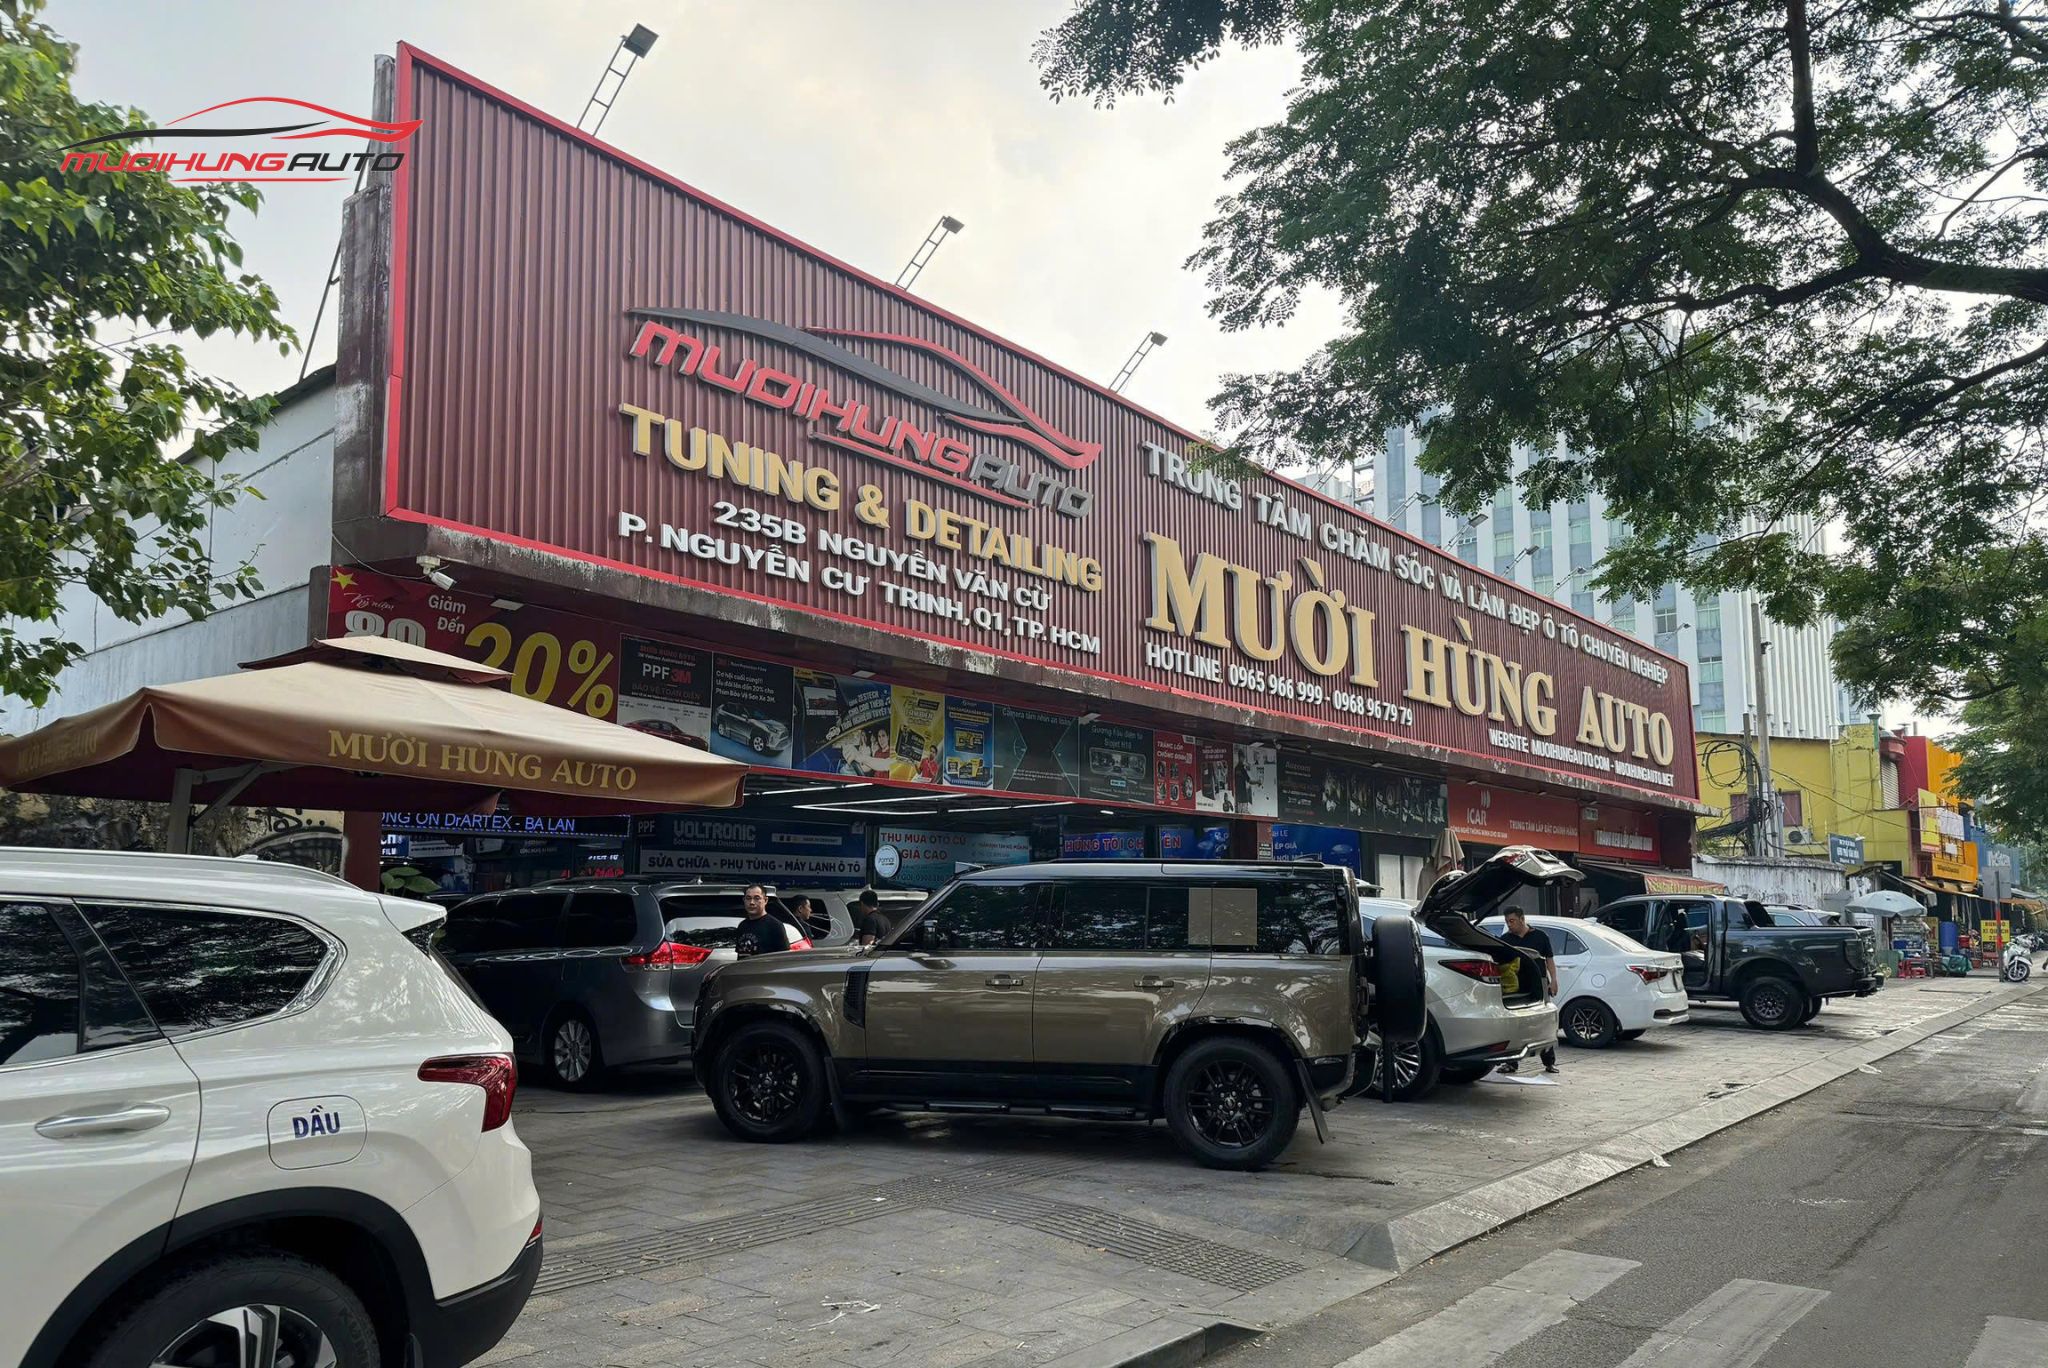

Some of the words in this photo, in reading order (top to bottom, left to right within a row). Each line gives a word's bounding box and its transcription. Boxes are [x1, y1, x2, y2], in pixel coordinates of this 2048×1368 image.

[619, 402, 840, 511] TUNING
[855, 484, 891, 529] &
[905, 499, 1102, 592] DETAILING
[619, 511, 653, 543] P.
[660, 522, 810, 582] NGUYỄN
[821, 566, 871, 596] CƯ
[713, 501, 806, 544] 235B
[953, 568, 1008, 601] VĂN
[1014, 584, 1052, 610] CỪ
[1141, 441, 1242, 511] TRUNG
[1252, 492, 1311, 540] TÂM
[1318, 521, 1390, 571] CHĂM
[1394, 552, 1435, 590] SÓC
[1440, 570, 1464, 603] VÀ
[1467, 583, 1505, 619] LÀM
[1508, 604, 1540, 635] ĐẸP
[1542, 613, 1555, 639] Ô
[1558, 622, 1578, 648] TÔ
[1581, 633, 1629, 669] CHUYÊN
[1630, 653, 1668, 688] NGHIỆP
[428, 594, 467, 615] Giảm
[437, 615, 467, 635] Đến
[1143, 531, 1379, 688] MƯỜI
[1401, 615, 1557, 736] HÙNG
[1576, 685, 1674, 766] AUTO
[464, 621, 614, 718] 20%
[642, 662, 670, 680] PPF
[1227, 663, 1266, 693] 0965
[1268, 673, 1294, 699] 966
[1296, 681, 1323, 705] 999
[1332, 689, 1365, 716] 0968
[327, 728, 429, 768] MƯỜI
[440, 741, 542, 781] HÙNG
[551, 758, 637, 791] AUTO
[524, 816, 544, 831] BA
[547, 818, 575, 832] LAN
[638, 820, 656, 833] PPF
[1466, 807, 1488, 826] ICAR
[673, 819, 757, 841] VOLTRONIC
[880, 832, 902, 842] THU
[904, 833, 928, 843] MUA
[648, 852, 674, 867] SỬA
[677, 855, 710, 868] CHỮA
[720, 858, 743, 873] PHỤ
[745, 858, 776, 871] TÙNG
[785, 858, 807, 872] MÁY
[808, 862, 836, 875] LẠNH
[837, 860, 846, 872] Ô
[847, 861, 861, 873] TÔ
[901, 846, 921, 859] GIÁ
[923, 850, 949, 861] CAO
[292, 1105, 340, 1138] DẦU
